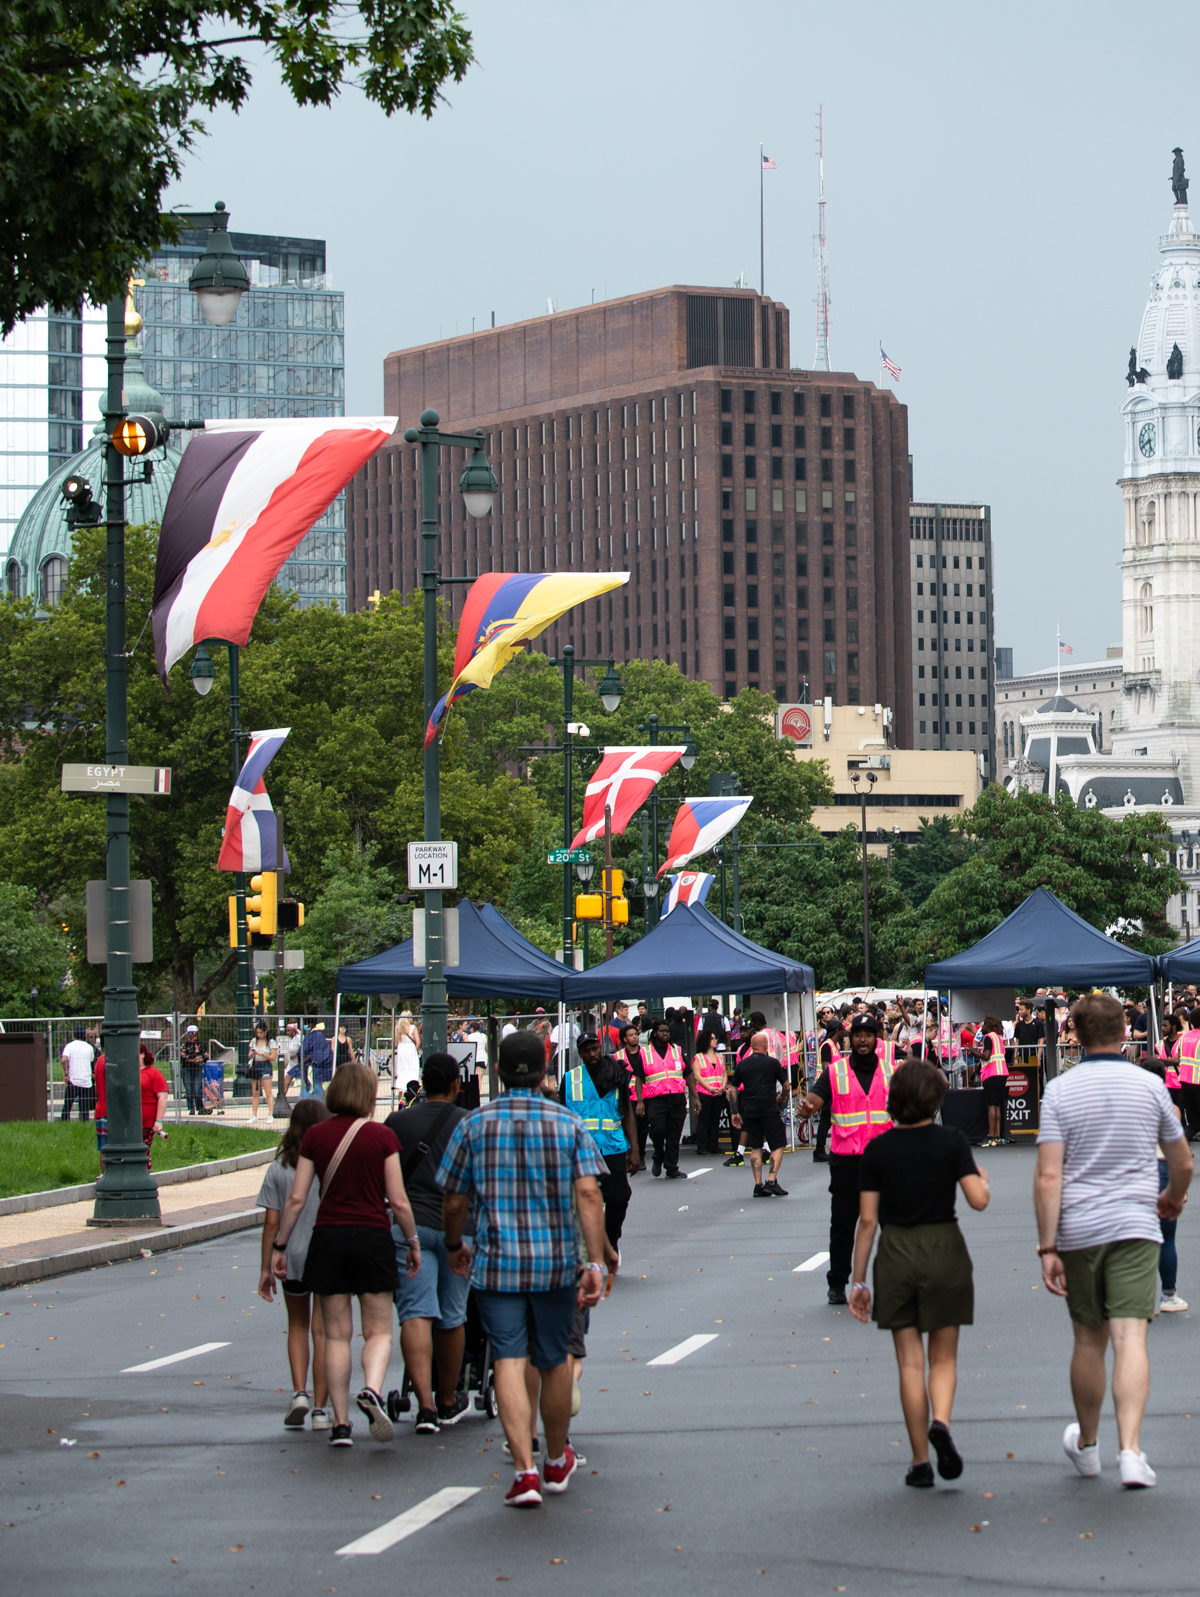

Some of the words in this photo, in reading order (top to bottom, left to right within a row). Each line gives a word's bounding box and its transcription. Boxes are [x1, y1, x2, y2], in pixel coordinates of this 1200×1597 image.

[86, 766, 126, 778] EGYPT
[91, 780, 121, 790] مصر
[556, 853, 575, 862] 20th
[578, 854, 590, 862] St
[418, 863, 444, 884] M-1
[1007, 1098, 1027, 1109] NO
